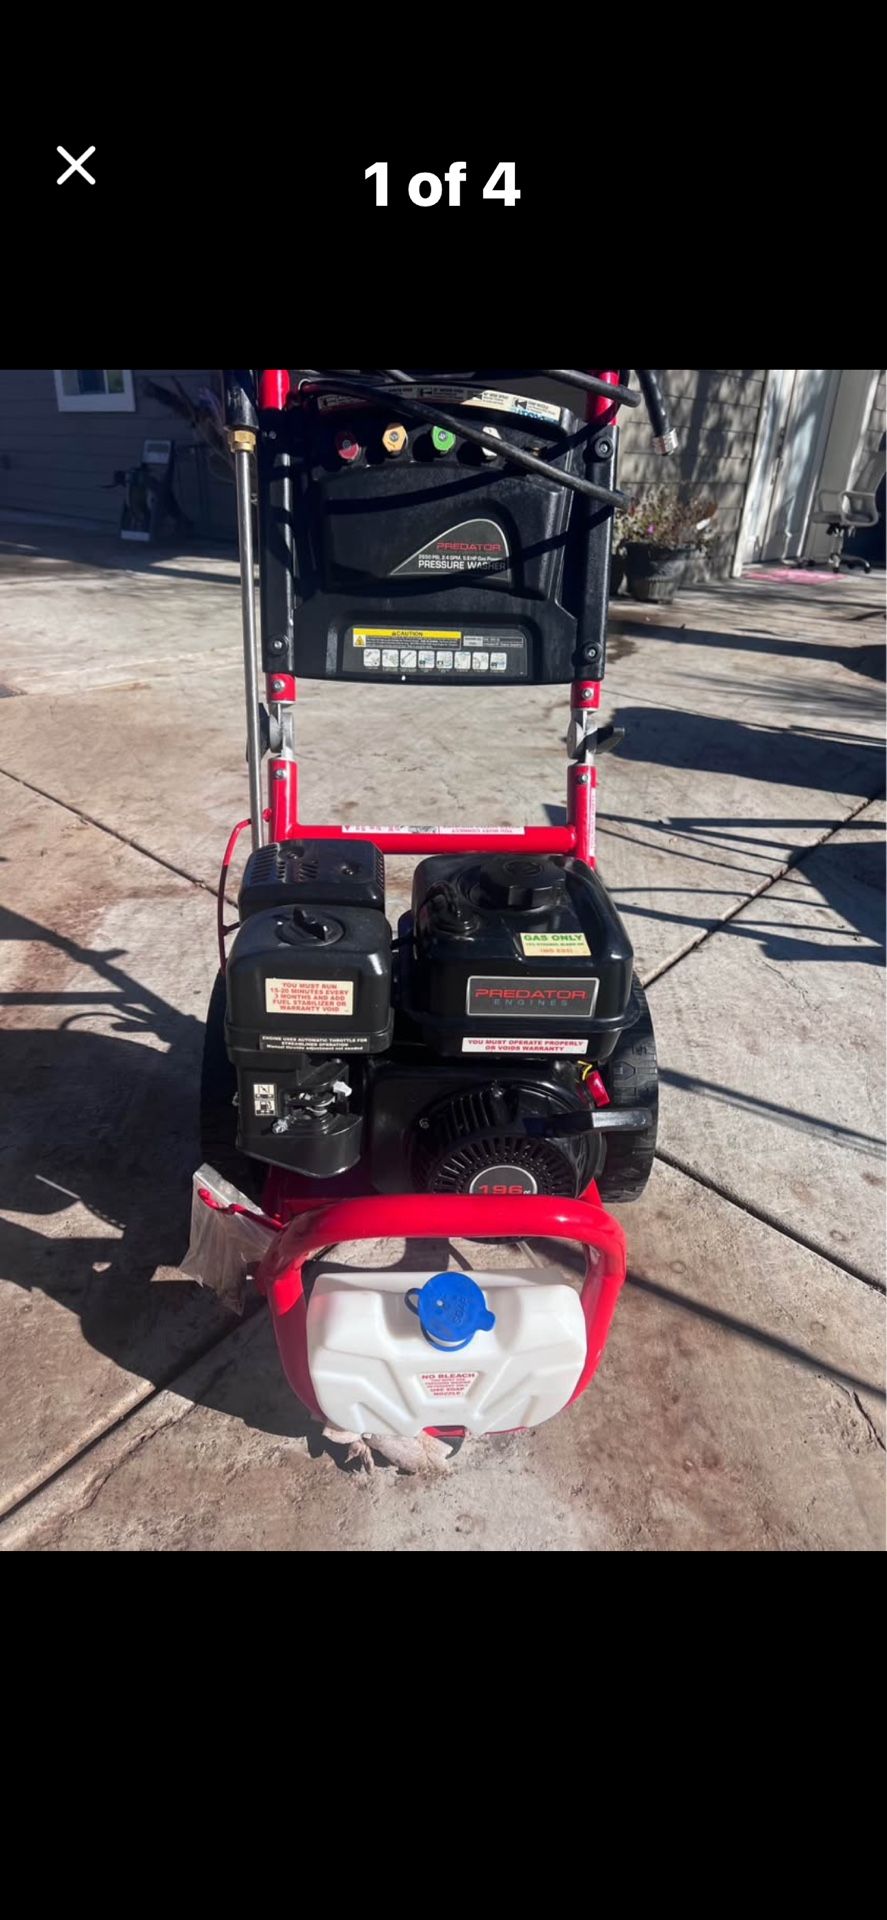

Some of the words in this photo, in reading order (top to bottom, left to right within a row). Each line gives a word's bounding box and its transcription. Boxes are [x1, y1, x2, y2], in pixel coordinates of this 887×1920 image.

[436, 542, 501, 552] PREDATOR
[418, 560, 464, 570] PRESSURE
[467, 561, 506, 570] WASHER
[475, 988, 586, 1000] PREDATOR
[479, 1184, 523, 1194] 196
